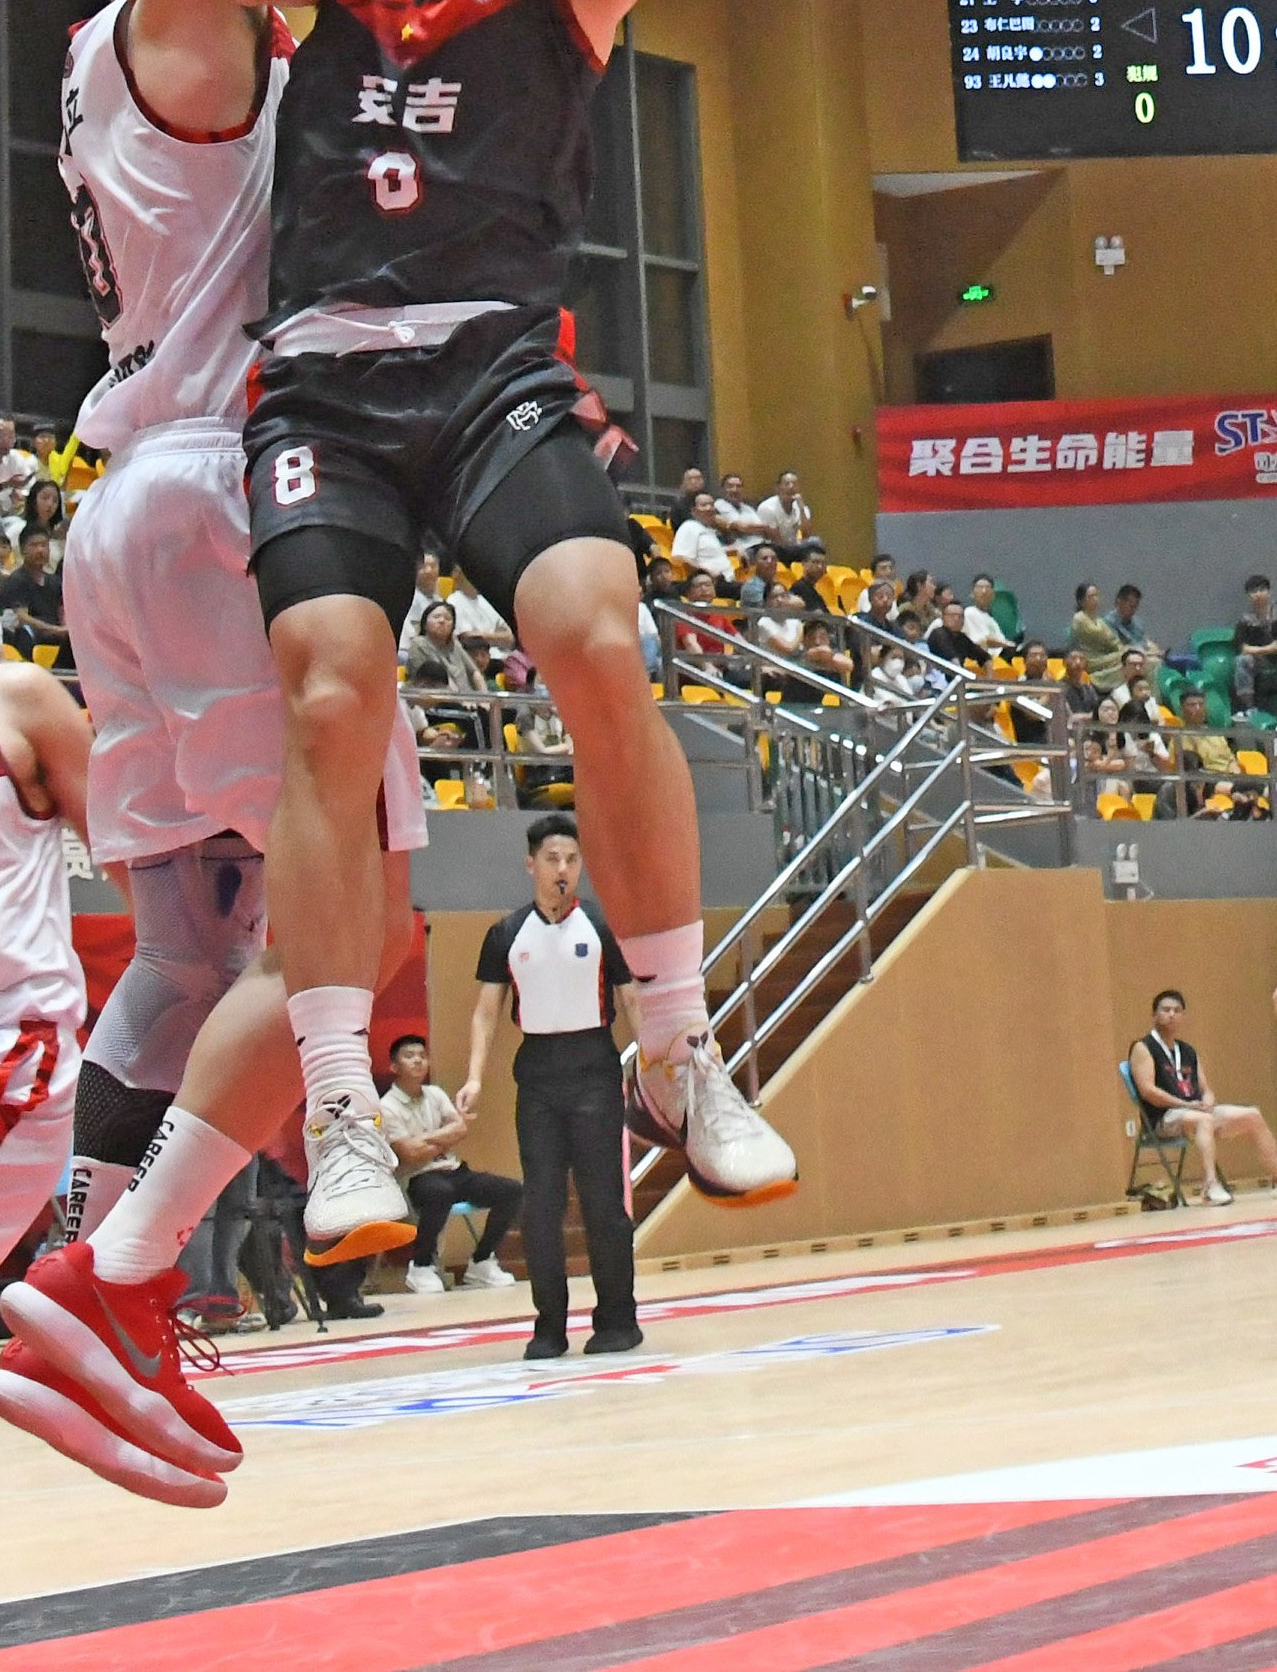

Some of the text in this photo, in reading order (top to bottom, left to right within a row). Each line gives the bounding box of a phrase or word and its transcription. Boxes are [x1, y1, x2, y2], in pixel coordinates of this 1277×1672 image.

[961, 19, 978, 33] 23
[1091, 17, 1100, 31] 2
[1182, 7, 1261, 74] 10
[963, 47, 979, 61] 24
[1093, 44, 1102, 58] 2
[352, 74, 462, 134] 安吉
[964, 75, 982, 89] 93
[1095, 72, 1104, 86] 3
[1135, 93, 1154, 123] 0
[275, 445, 317, 506] 8
[908, 429, 1193, 477] 聚合生命能量
[127, 1119, 176, 1193] CAREER
[65, 1167, 93, 1246] CAREER
